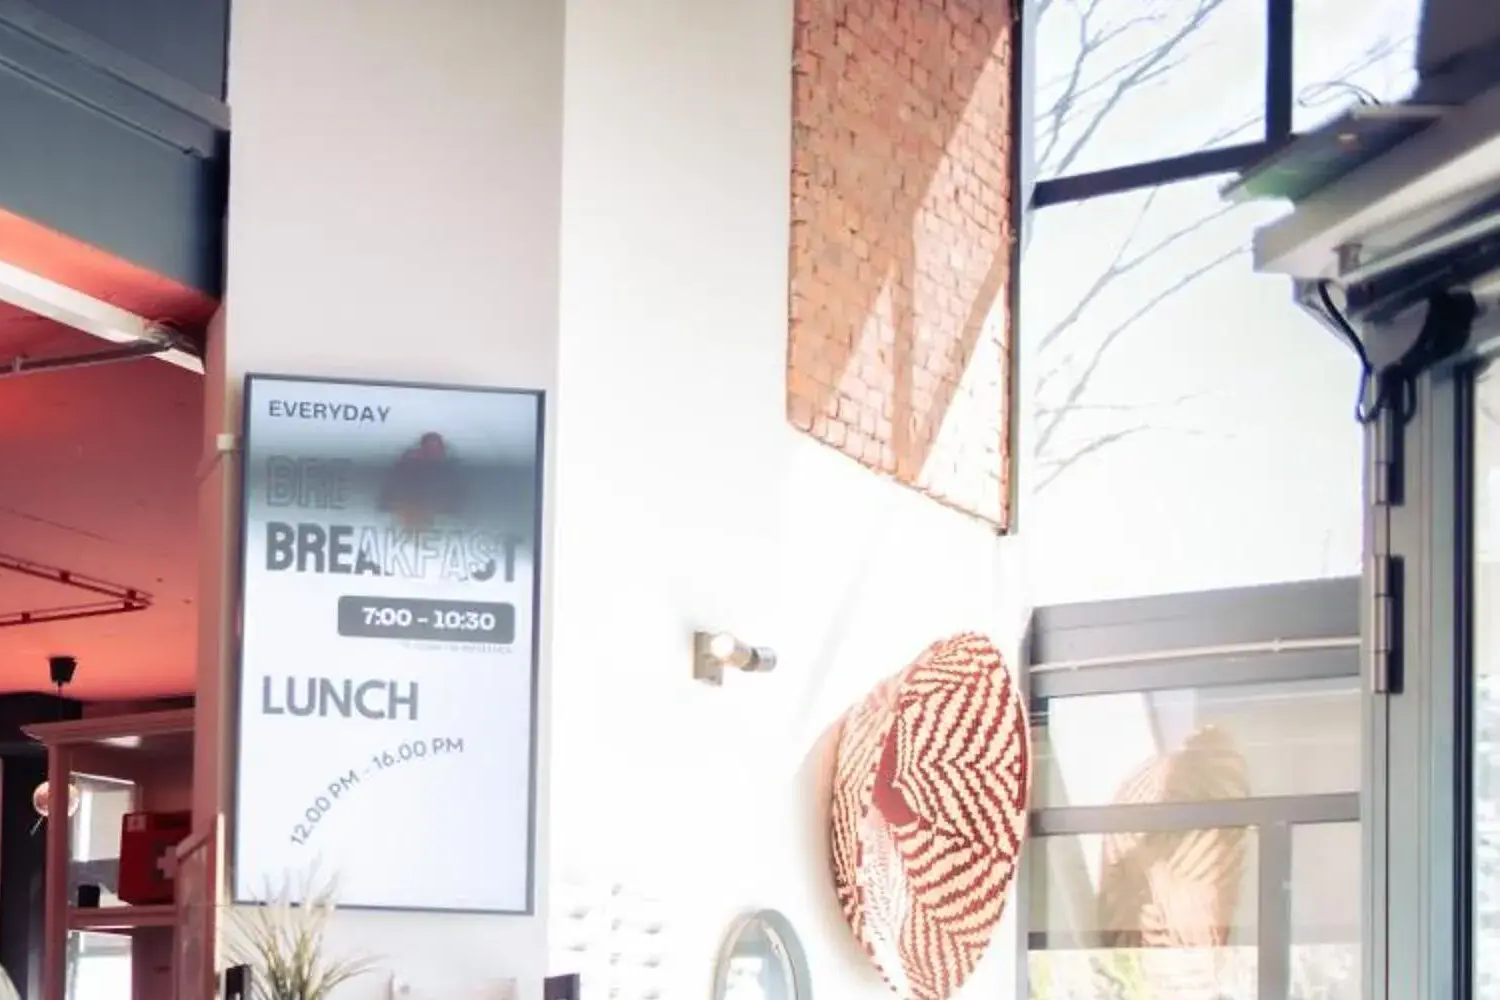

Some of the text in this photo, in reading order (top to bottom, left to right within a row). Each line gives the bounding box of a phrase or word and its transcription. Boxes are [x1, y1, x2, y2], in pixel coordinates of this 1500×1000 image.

[268, 400, 390, 423] EVERYDAY
[265, 521, 522, 583] BREAKFAST
[361, 607, 412, 627] 7:00
[433, 611, 495, 631] 10:30
[262, 675, 418, 721] LUNCH
[290, 797, 332, 845] 12.00
[327, 769, 360, 799] PM
[373, 740, 427, 769] 16.00
[432, 737, 464, 754] PM
